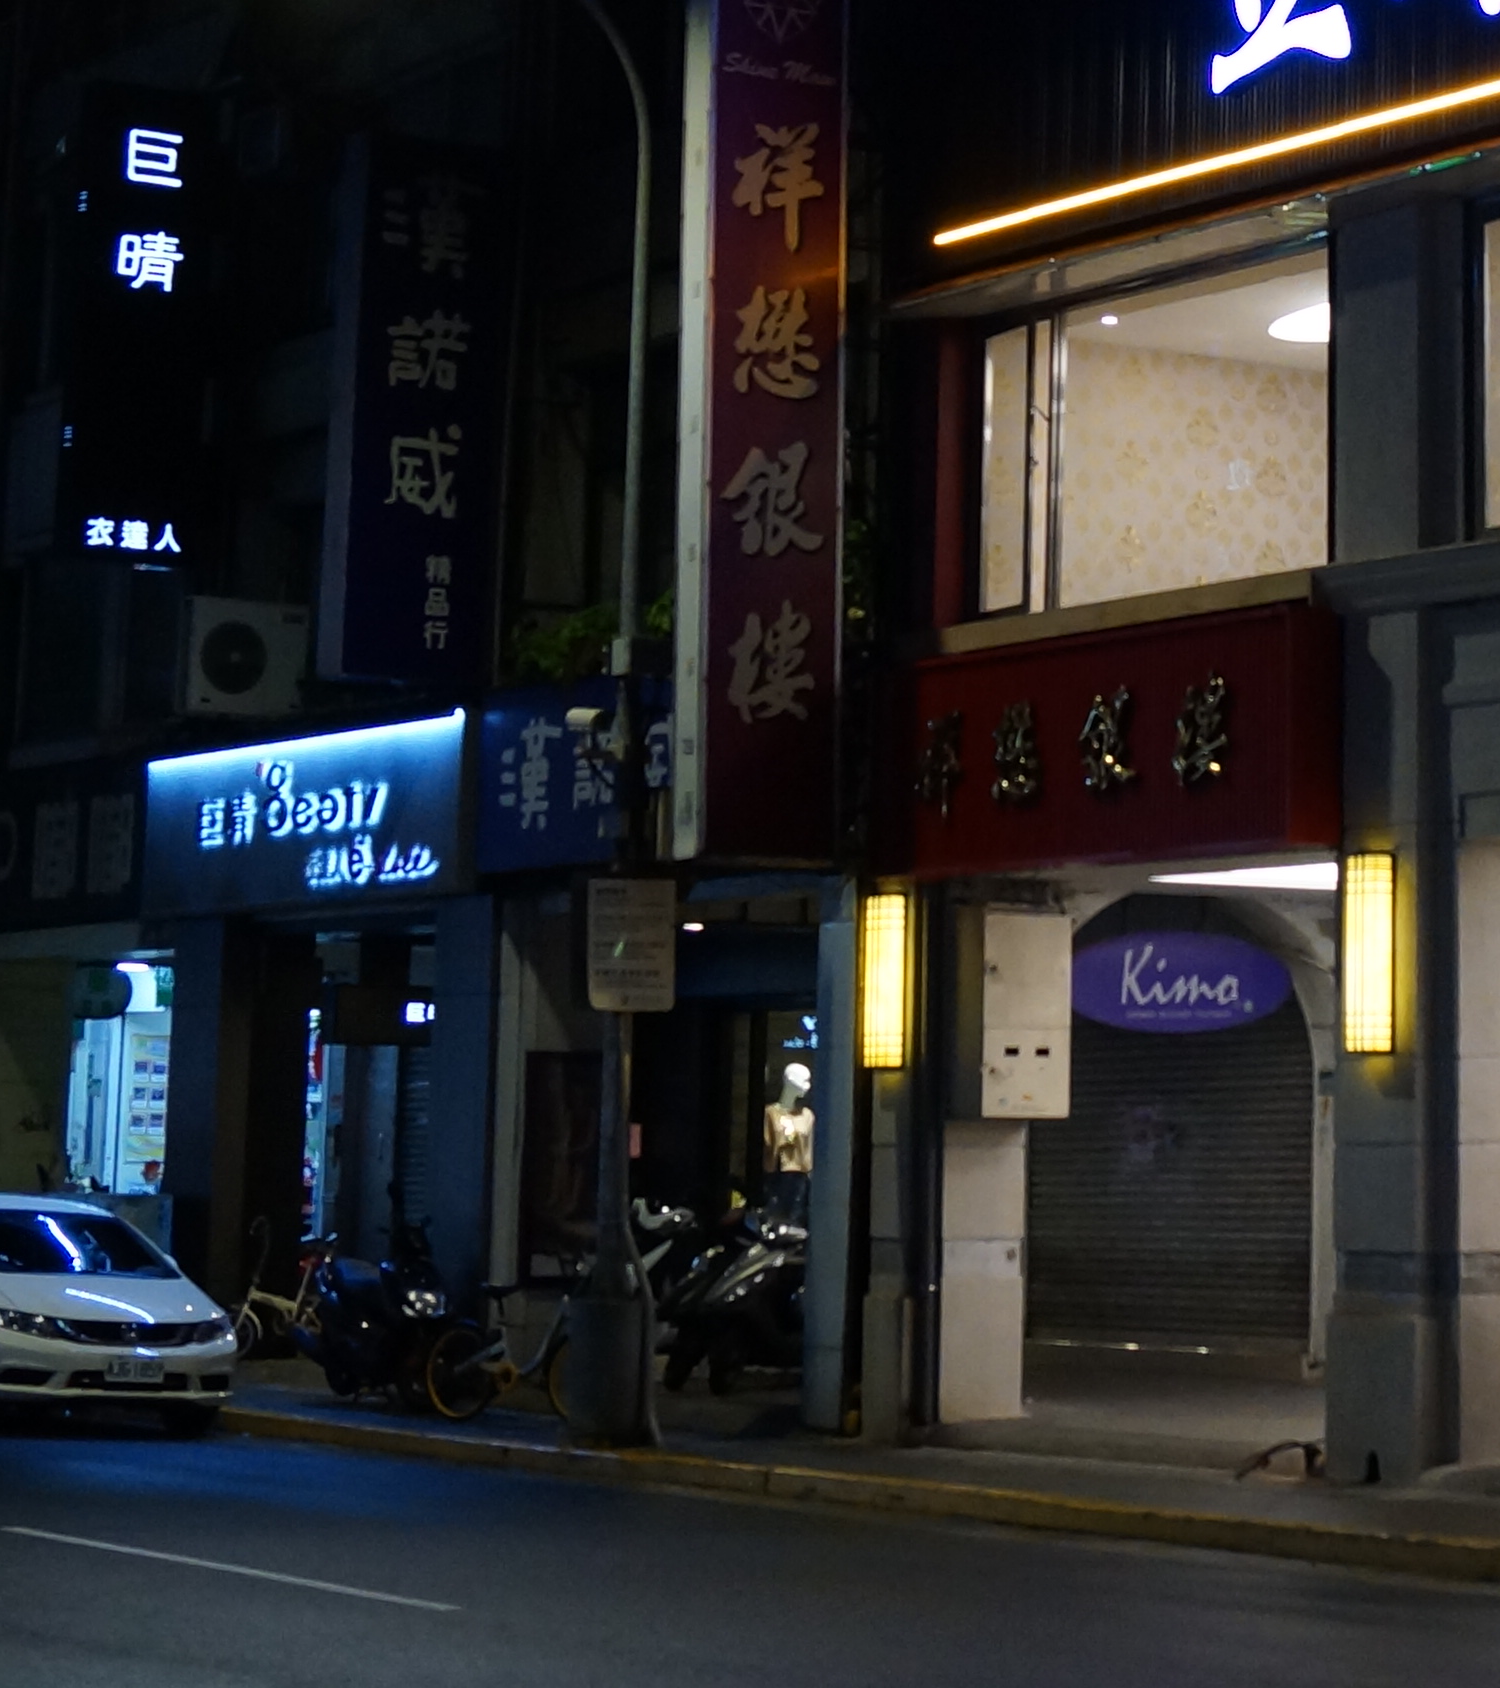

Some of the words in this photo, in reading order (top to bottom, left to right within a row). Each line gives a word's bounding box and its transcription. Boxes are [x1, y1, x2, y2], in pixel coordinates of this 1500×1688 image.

[117, 127, 185, 293] 巨晴
[381, 170, 488, 519] 漢諾威
[86, 516, 182, 553] 衣達人
[423, 553, 454, 651] 精品行
